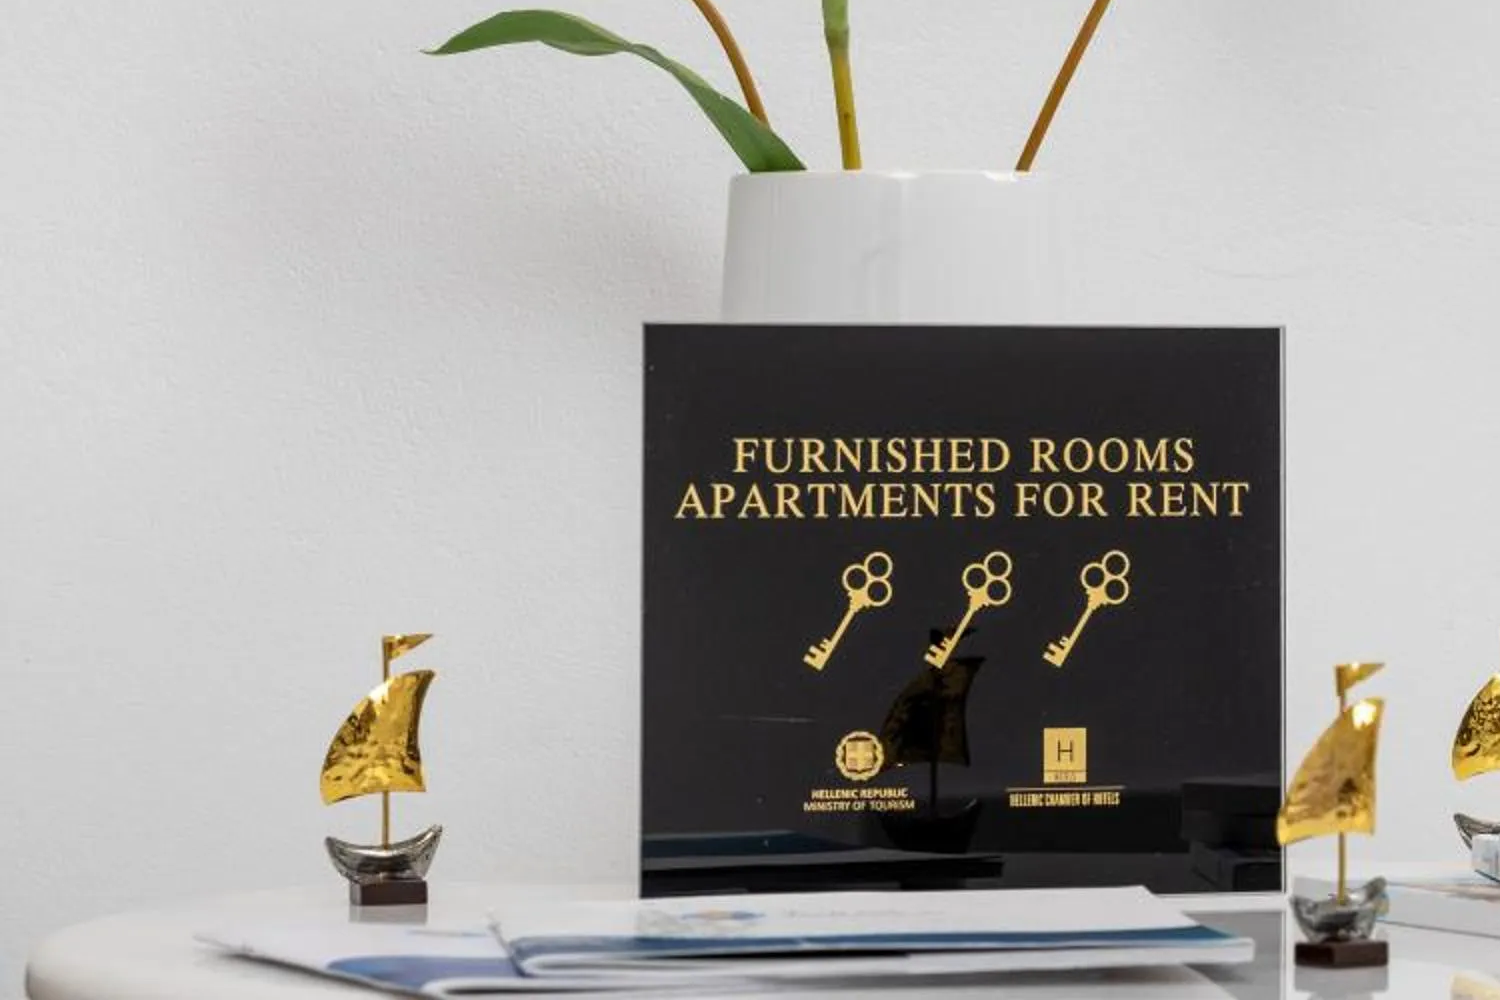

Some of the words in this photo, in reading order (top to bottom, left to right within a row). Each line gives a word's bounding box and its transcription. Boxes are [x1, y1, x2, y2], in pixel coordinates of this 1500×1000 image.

[732, 437, 1010, 474] FURNISHED
[1030, 437, 1195, 473] ROOMS
[674, 482, 996, 519] APARTMENTS
[1015, 481, 1109, 517] FOR
[1126, 481, 1250, 517] RENT
[803, 801, 851, 812] MINISTRY
[852, 801, 867, 812] OF
[870, 799, 916, 812] TOURISM
[810, 788, 858, 800] HELLENIC
[861, 787, 909, 799] REPUBLIC
